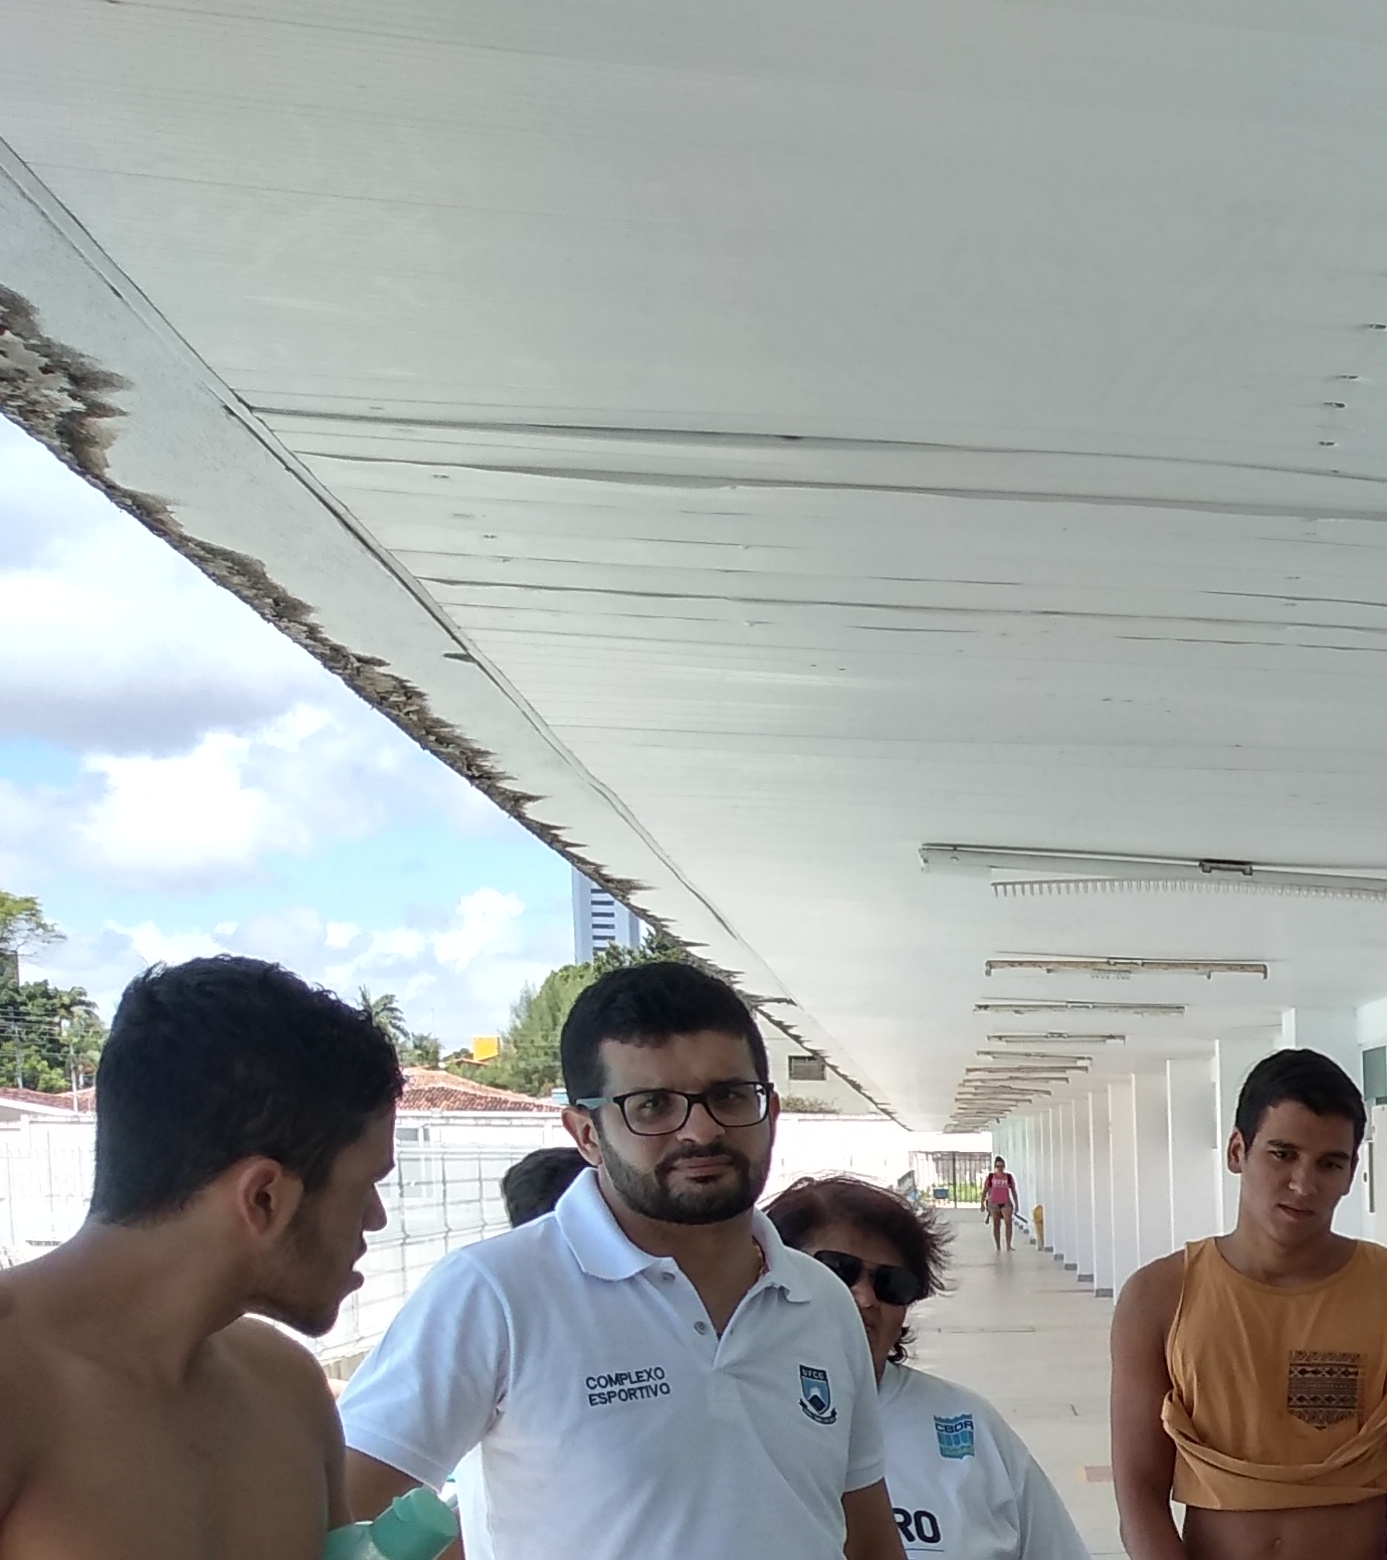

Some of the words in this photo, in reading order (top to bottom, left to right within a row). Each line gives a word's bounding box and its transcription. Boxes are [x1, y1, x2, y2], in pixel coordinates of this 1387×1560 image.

[586, 1366, 666, 1390] COMPLEXO
[802, 1368, 825, 1379] UFCG
[588, 1382, 671, 1406] ESPORTIVO
